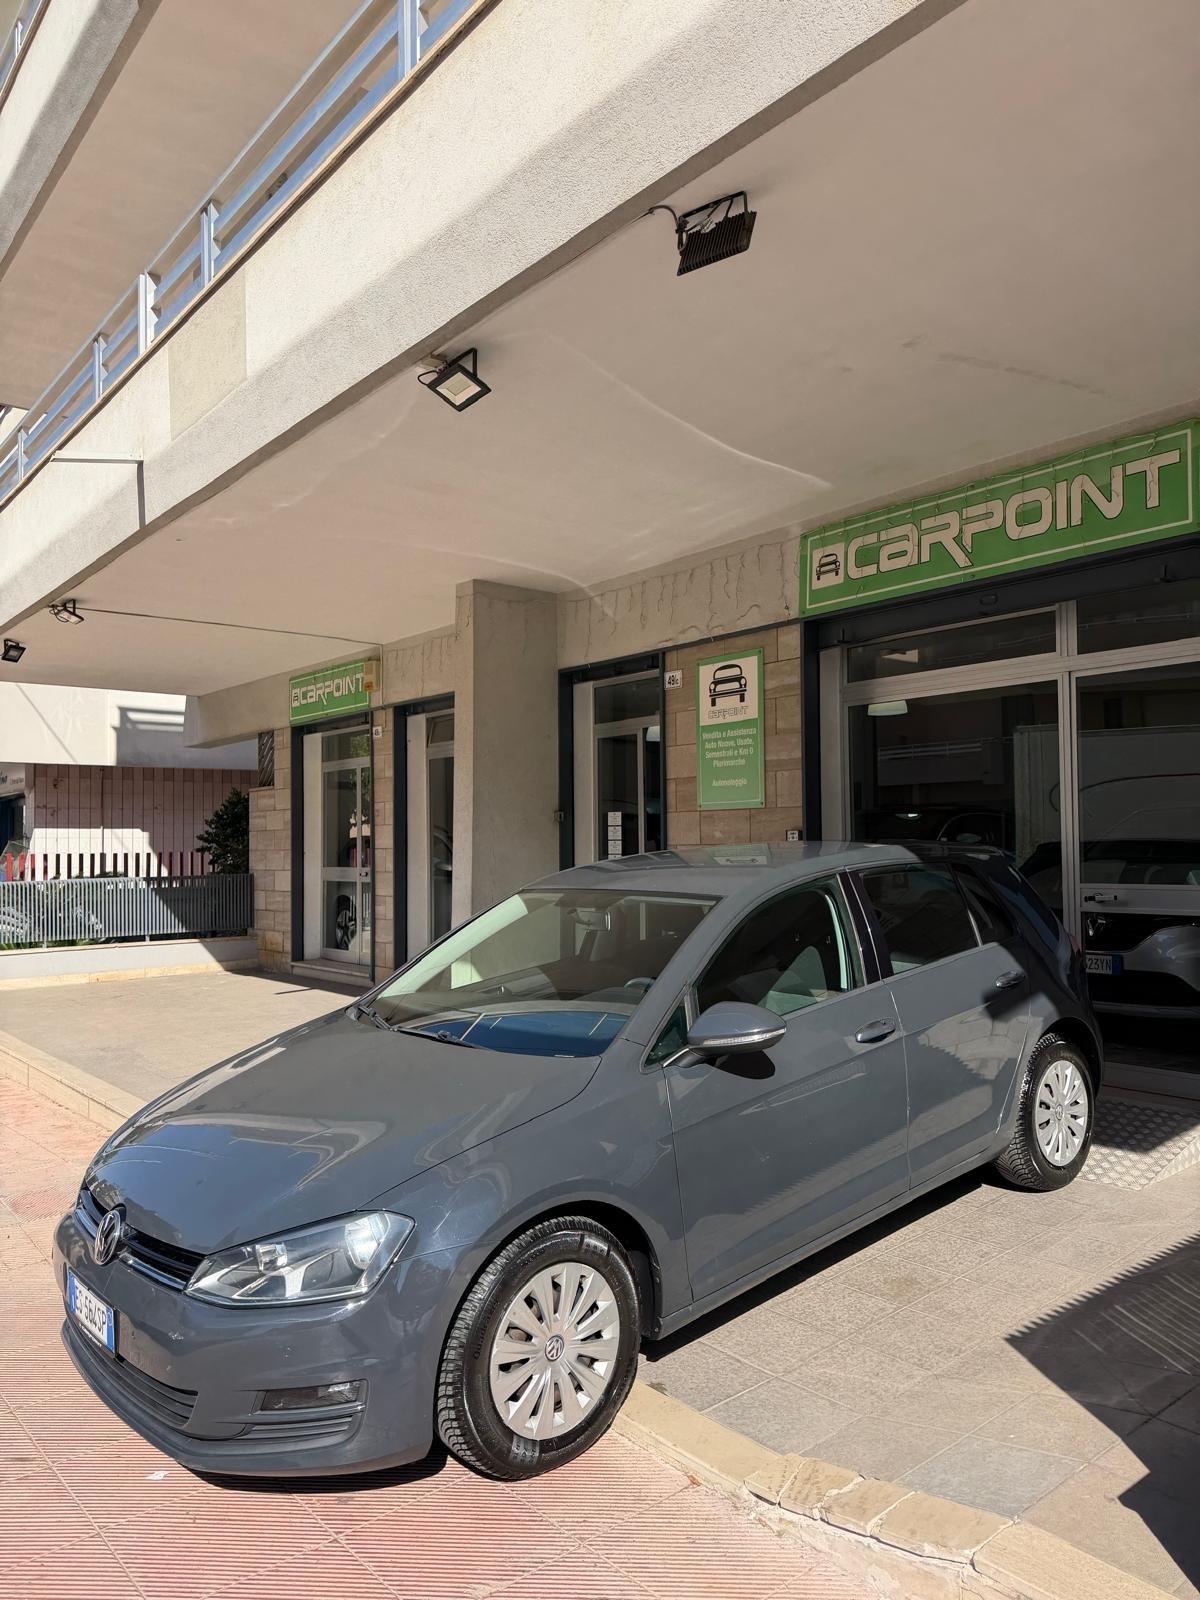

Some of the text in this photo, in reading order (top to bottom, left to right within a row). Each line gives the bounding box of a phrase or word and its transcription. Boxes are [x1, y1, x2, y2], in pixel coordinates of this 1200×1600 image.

[727, 727, 757, 737] Assistenza
[705, 741, 717, 749] Auto
[704, 748, 734, 759] Semestrali
[739, 747, 749, 756] Km
